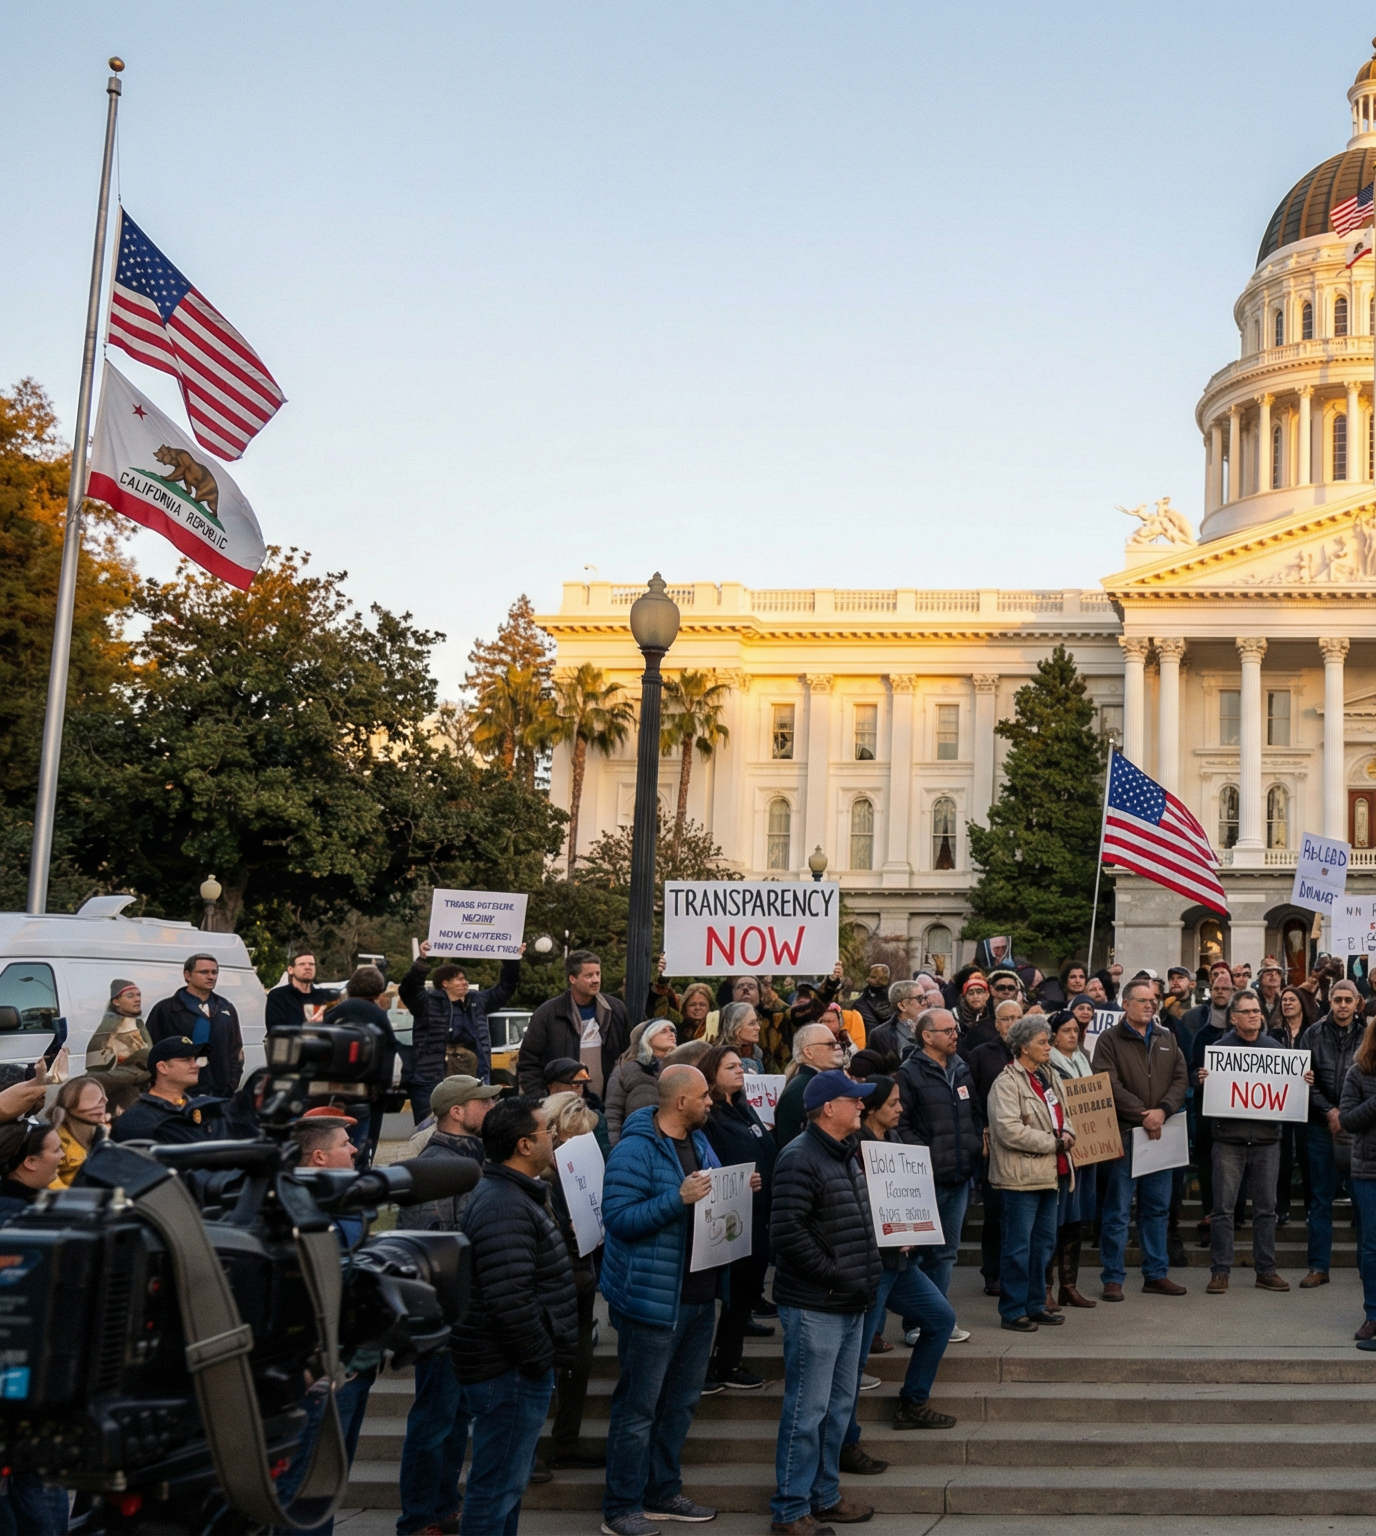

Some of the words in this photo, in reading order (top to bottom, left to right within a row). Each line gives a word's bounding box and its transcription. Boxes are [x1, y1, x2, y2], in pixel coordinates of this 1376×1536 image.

[668, 888, 835, 917] TRANSPARENCY
[705, 925, 806, 967] NOW
[1207, 1050, 1309, 1077] TRANSPARENCY
[1231, 1081, 1289, 1112] NOW
